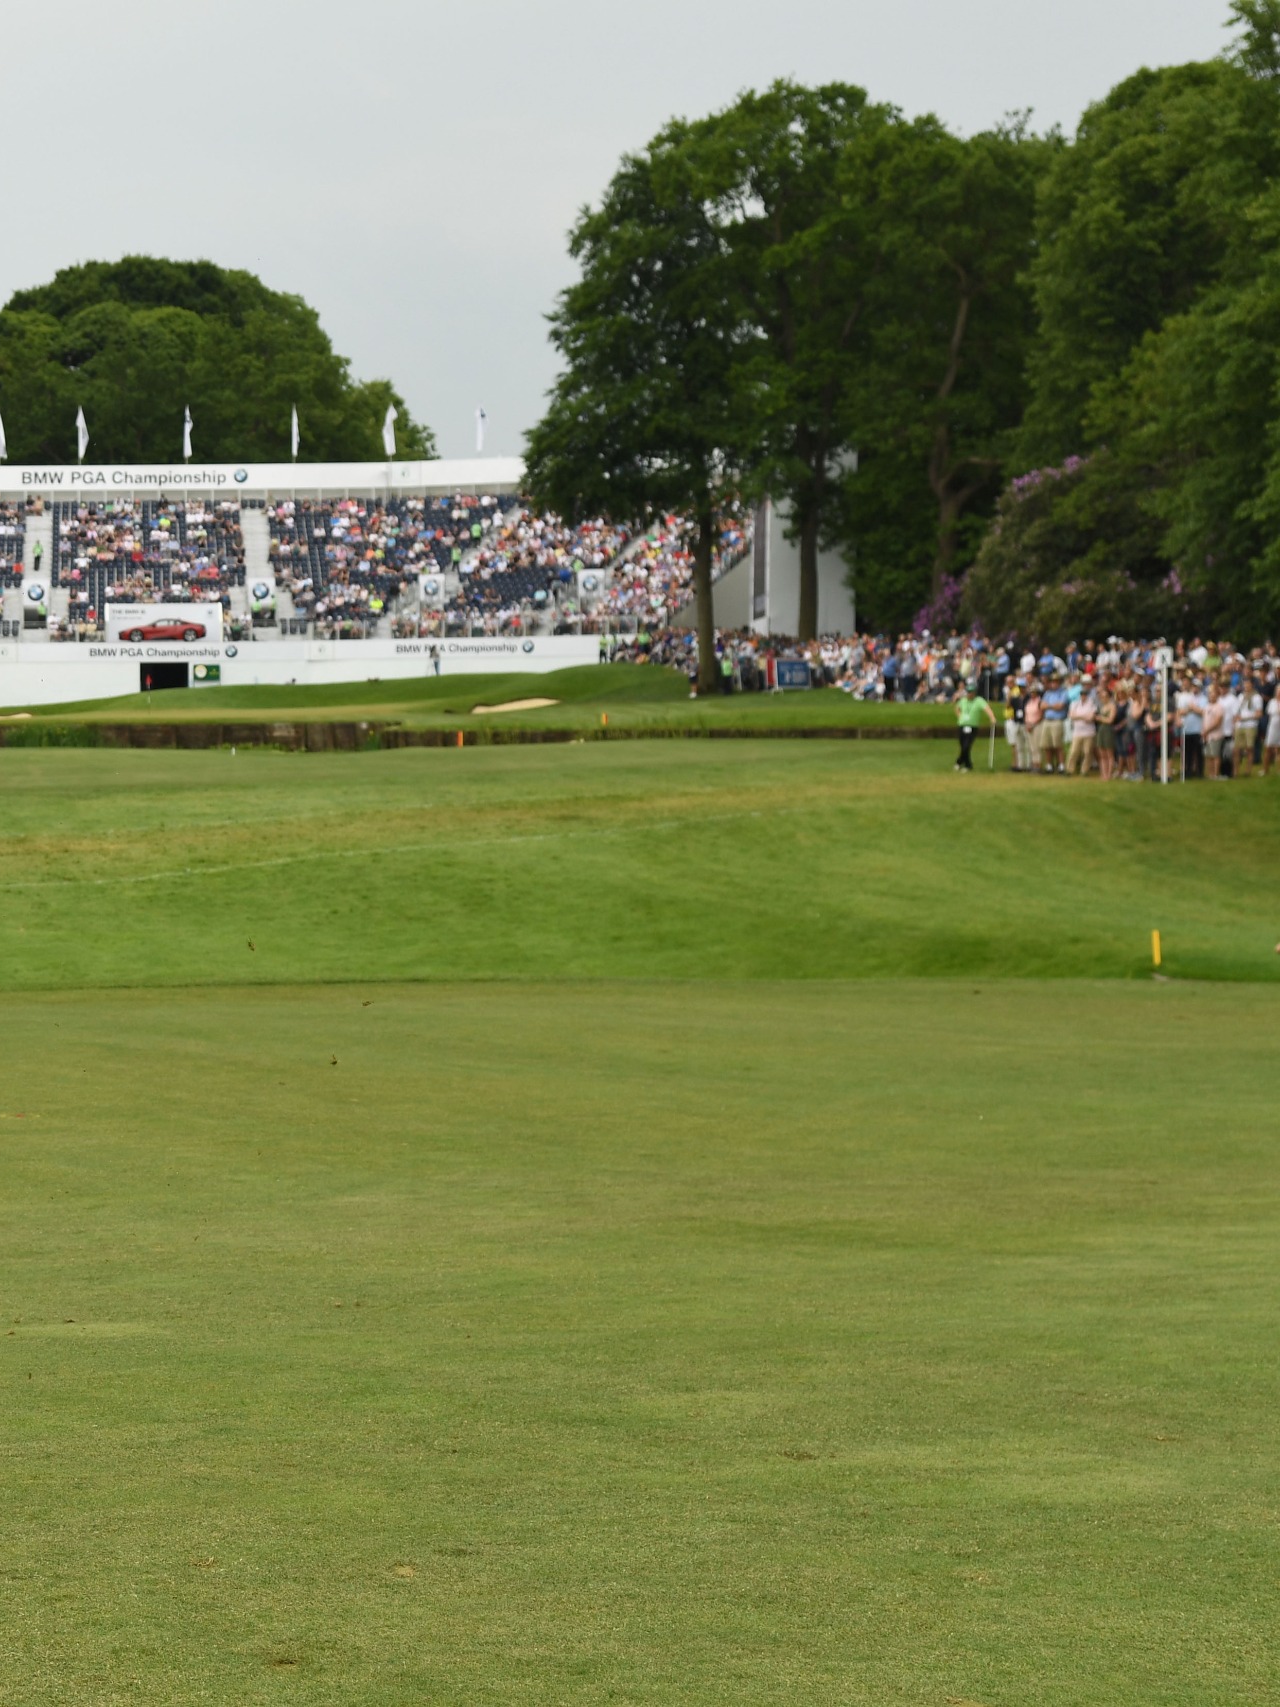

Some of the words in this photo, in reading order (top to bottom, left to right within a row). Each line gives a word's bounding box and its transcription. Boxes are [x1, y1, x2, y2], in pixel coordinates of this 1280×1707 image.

[21, 471, 64, 485] BMW
[71, 471, 106, 484] PGA
[112, 470, 226, 486] Championship
[89, 648, 117, 657] BMW
[120, 648, 143, 657] PGA
[146, 648, 220, 658] Championship
[396, 644, 420, 653] BMW
[424, 643, 446, 652] PA
[448, 643, 518, 653] Championship
